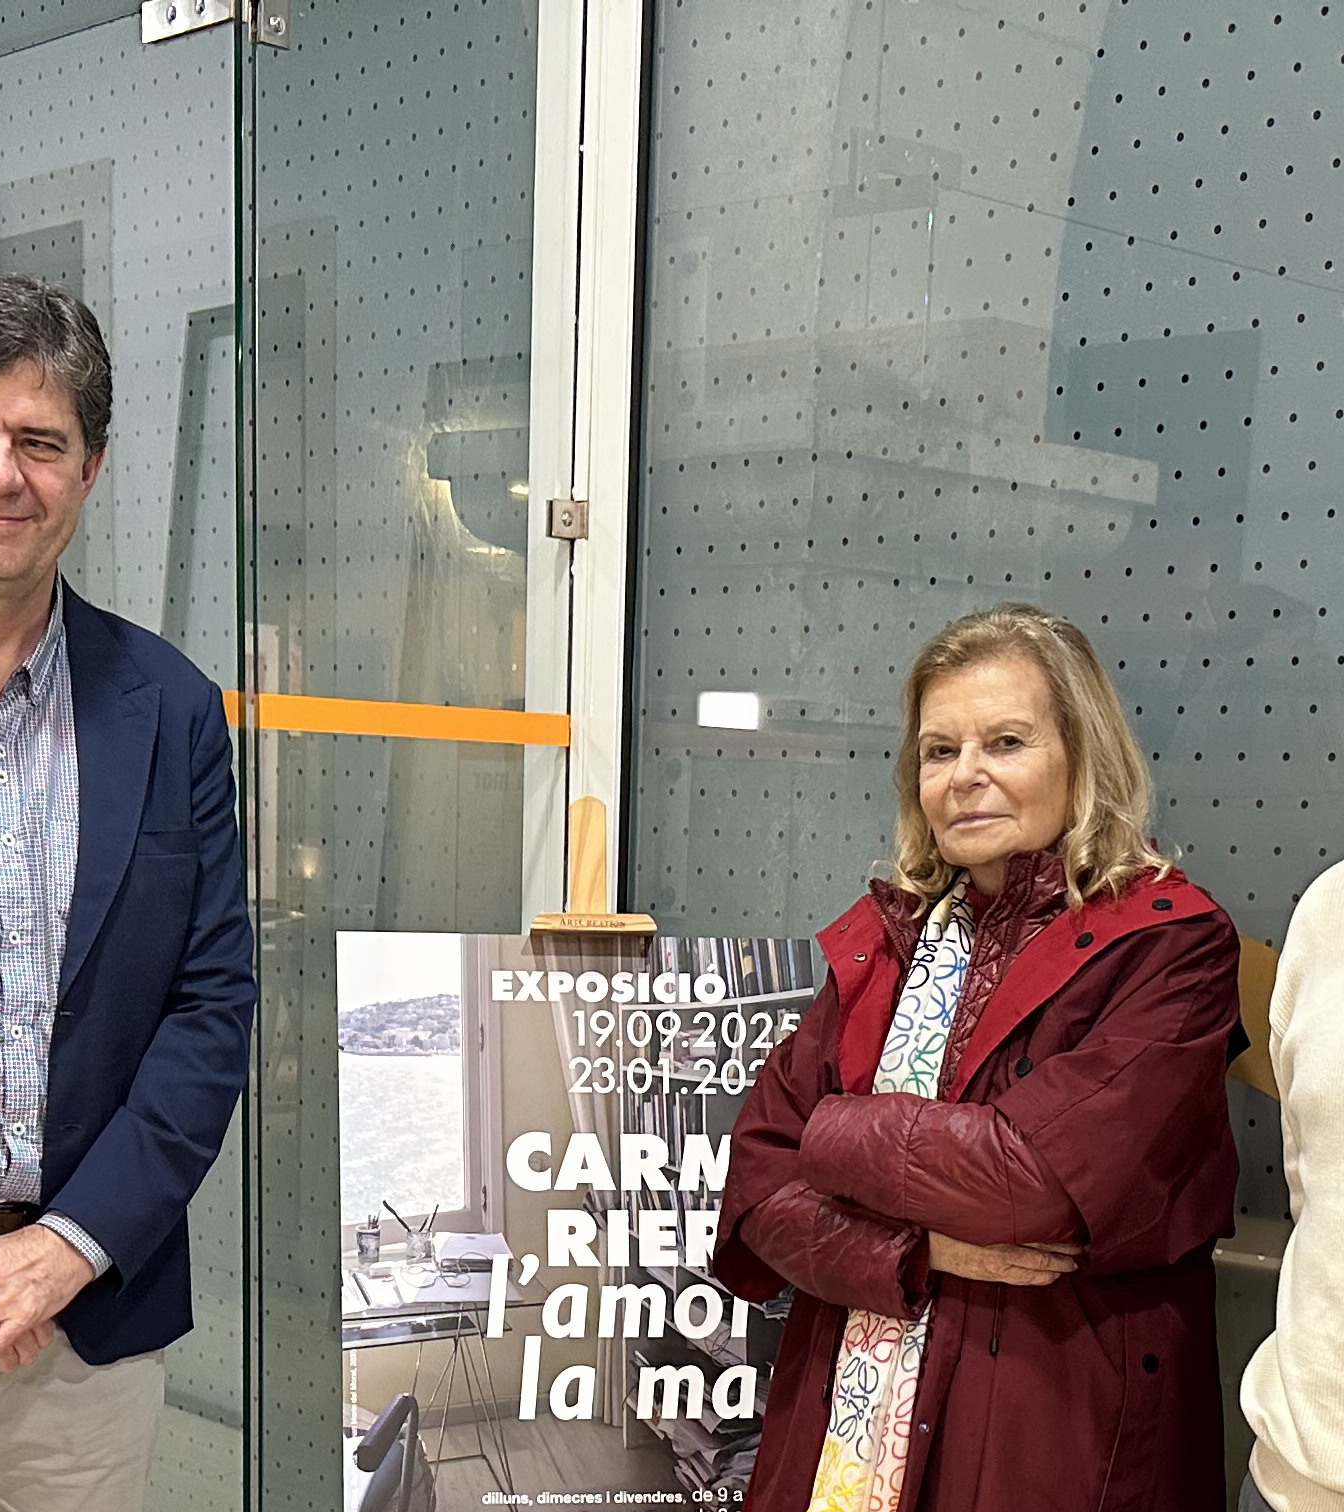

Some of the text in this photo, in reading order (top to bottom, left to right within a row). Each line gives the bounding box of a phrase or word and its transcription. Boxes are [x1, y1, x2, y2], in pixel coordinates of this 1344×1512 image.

[491, 963, 727, 1004] EXPOSICIÓ
[568, 1057, 766, 1095] 23.01.20
[506, 1131, 732, 1192] CARM
[547, 1209, 721, 1267] RIER
[518, 1335, 774, 1420] la ma
[481, 1491, 533, 1507] dilluns,
[536, 1491, 603, 1505] dimecres
[613, 1490, 687, 1505] divendres,
[691, 1486, 713, 1502] de
[717, 1487, 728, 1502] 9
[732, 1490, 743, 1502] a
